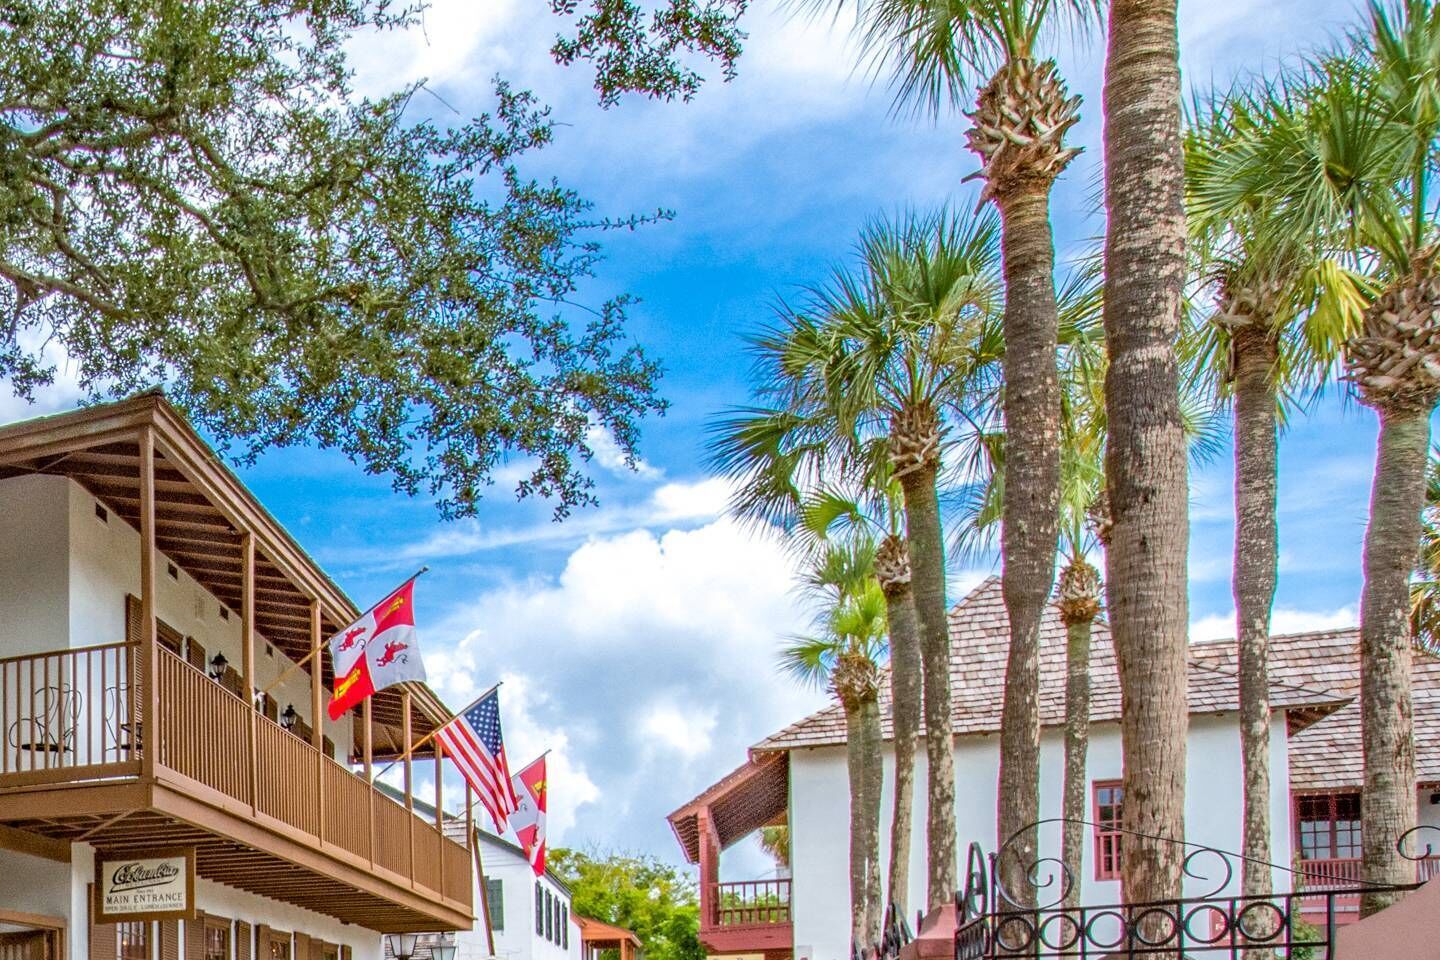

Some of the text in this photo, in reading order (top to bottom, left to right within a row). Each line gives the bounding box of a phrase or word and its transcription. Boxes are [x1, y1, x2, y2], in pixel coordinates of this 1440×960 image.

[112, 862, 179, 886] Columbia
[106, 892, 183, 904] MAIN ENTRANCE
